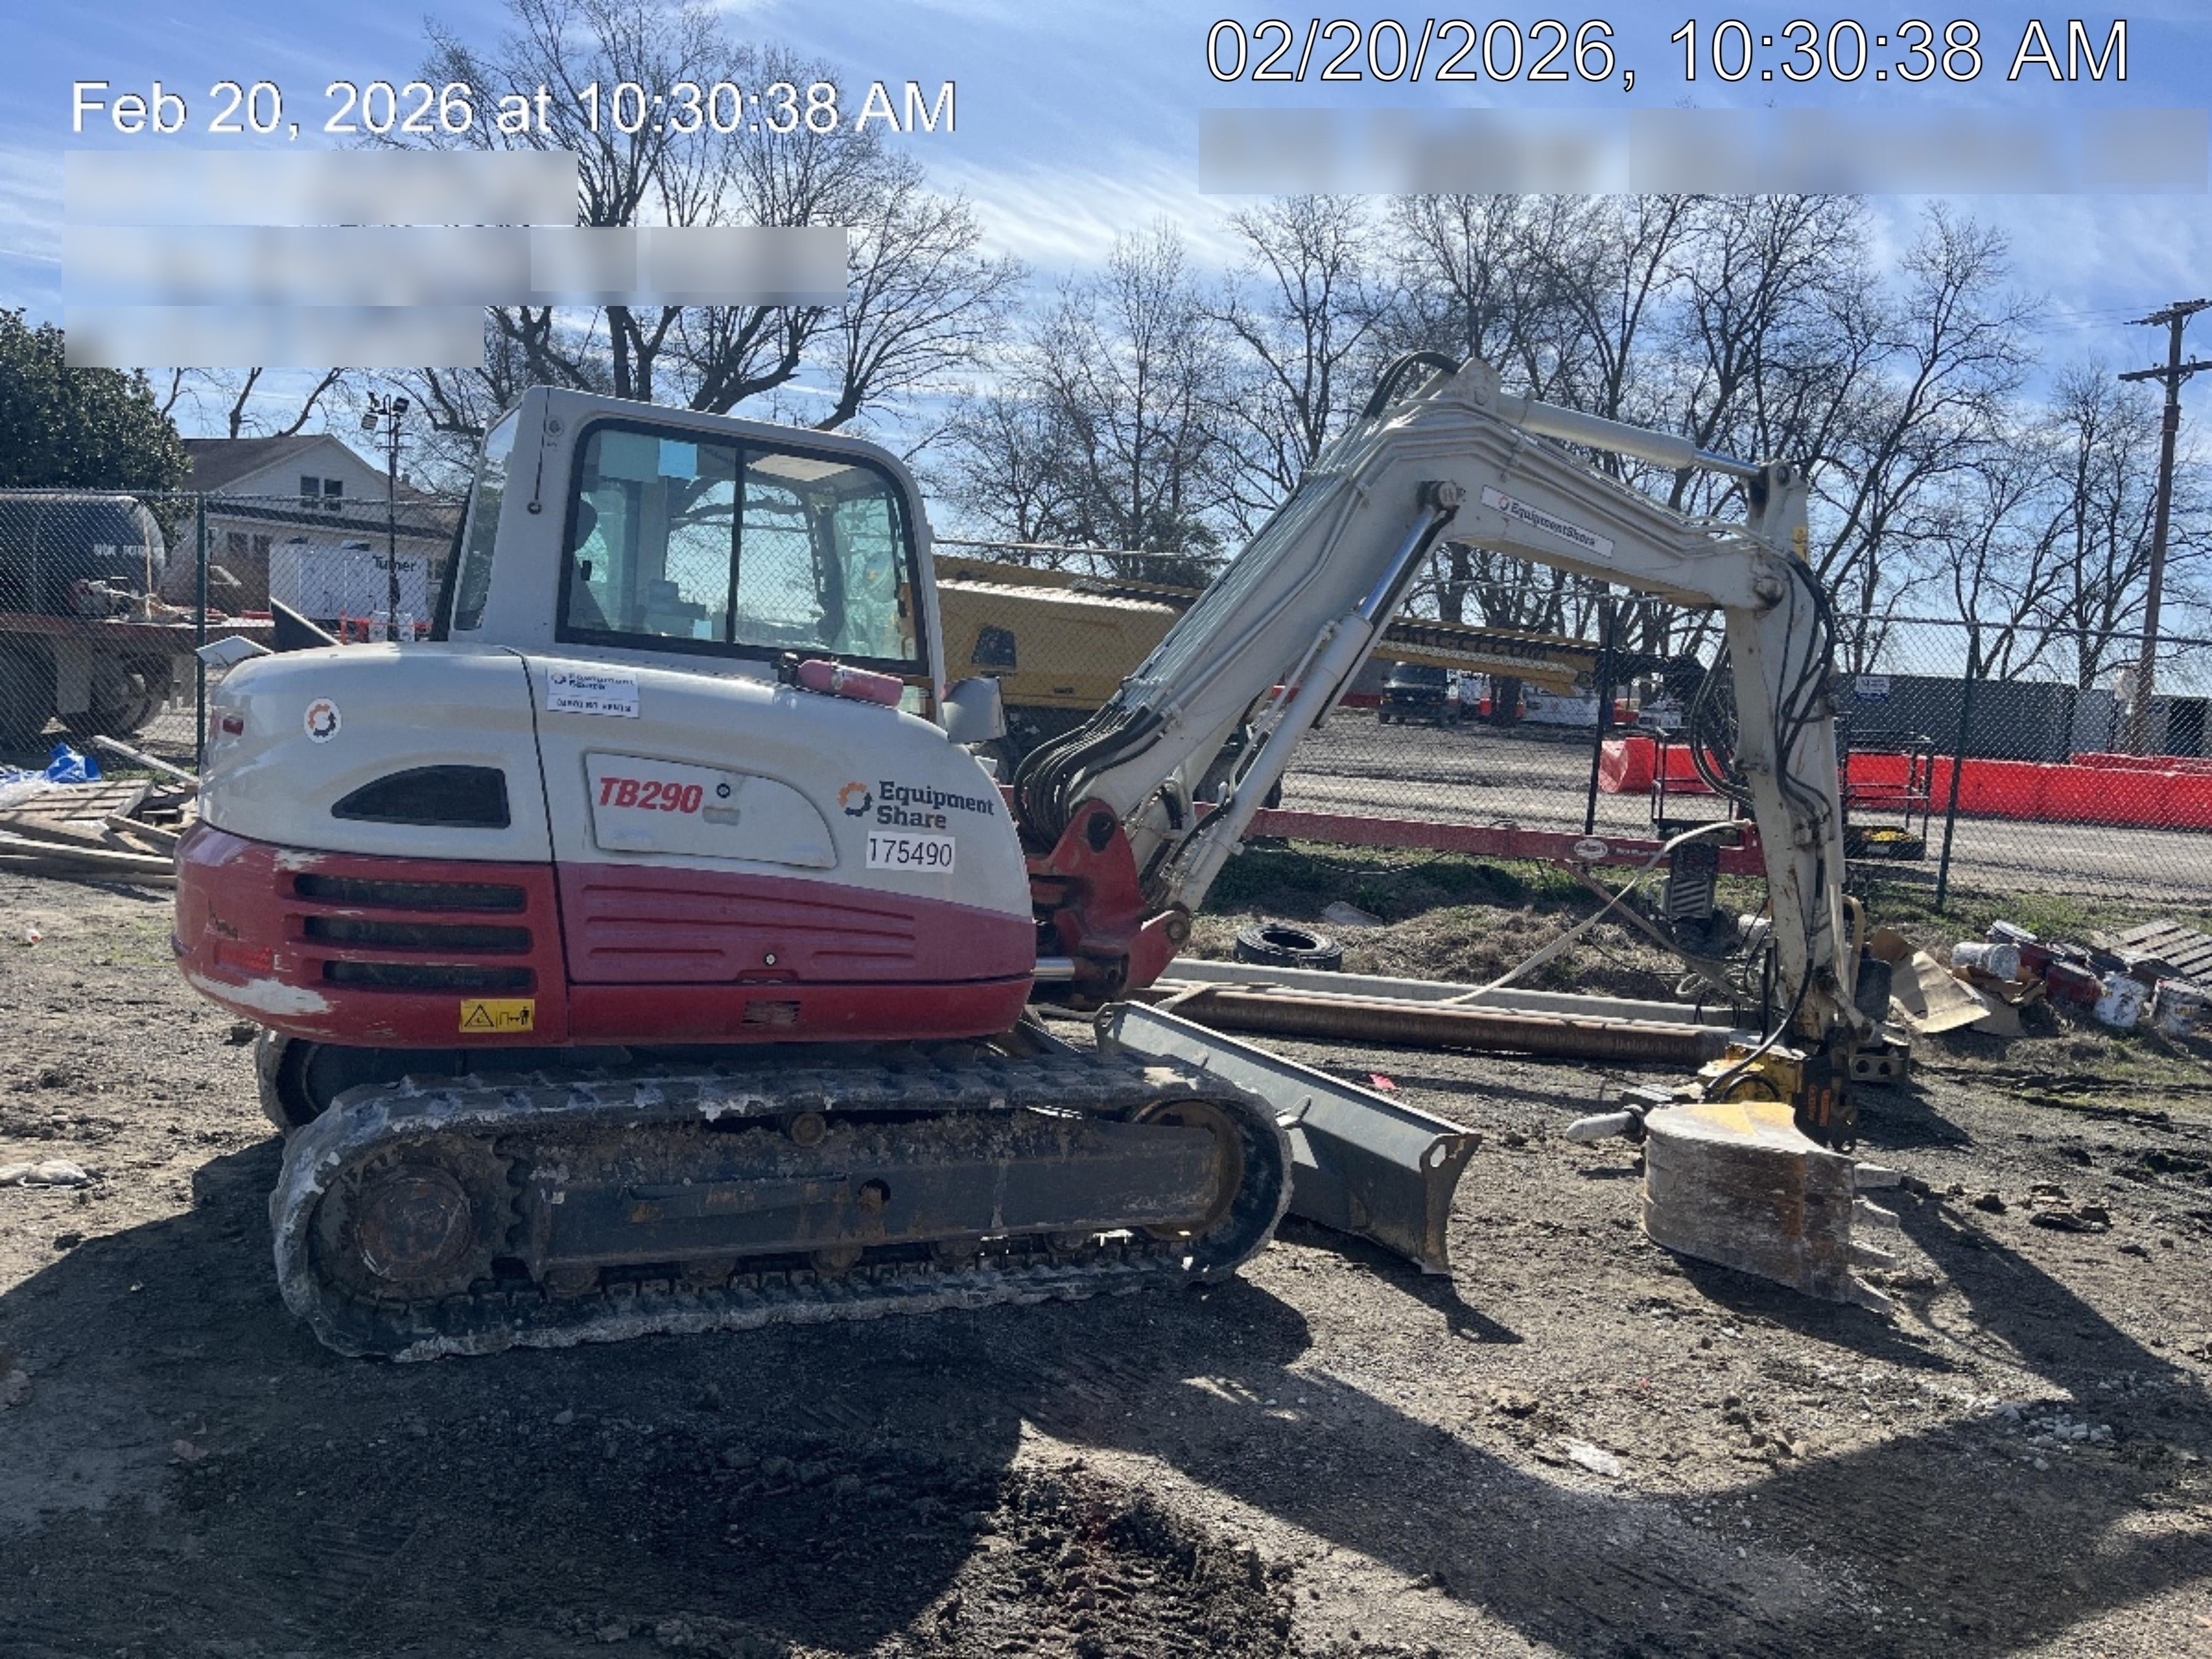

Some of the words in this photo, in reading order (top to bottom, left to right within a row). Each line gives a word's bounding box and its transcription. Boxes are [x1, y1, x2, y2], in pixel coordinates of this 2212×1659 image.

[1510, 500, 1596, 547] EquipmentShare
[372, 554, 417, 572] Tuner
[598, 777, 704, 814] TB290
[879, 780, 994, 815] Equipment
[877, 804, 947, 829] Share
[869, 838, 952, 867] 175490
